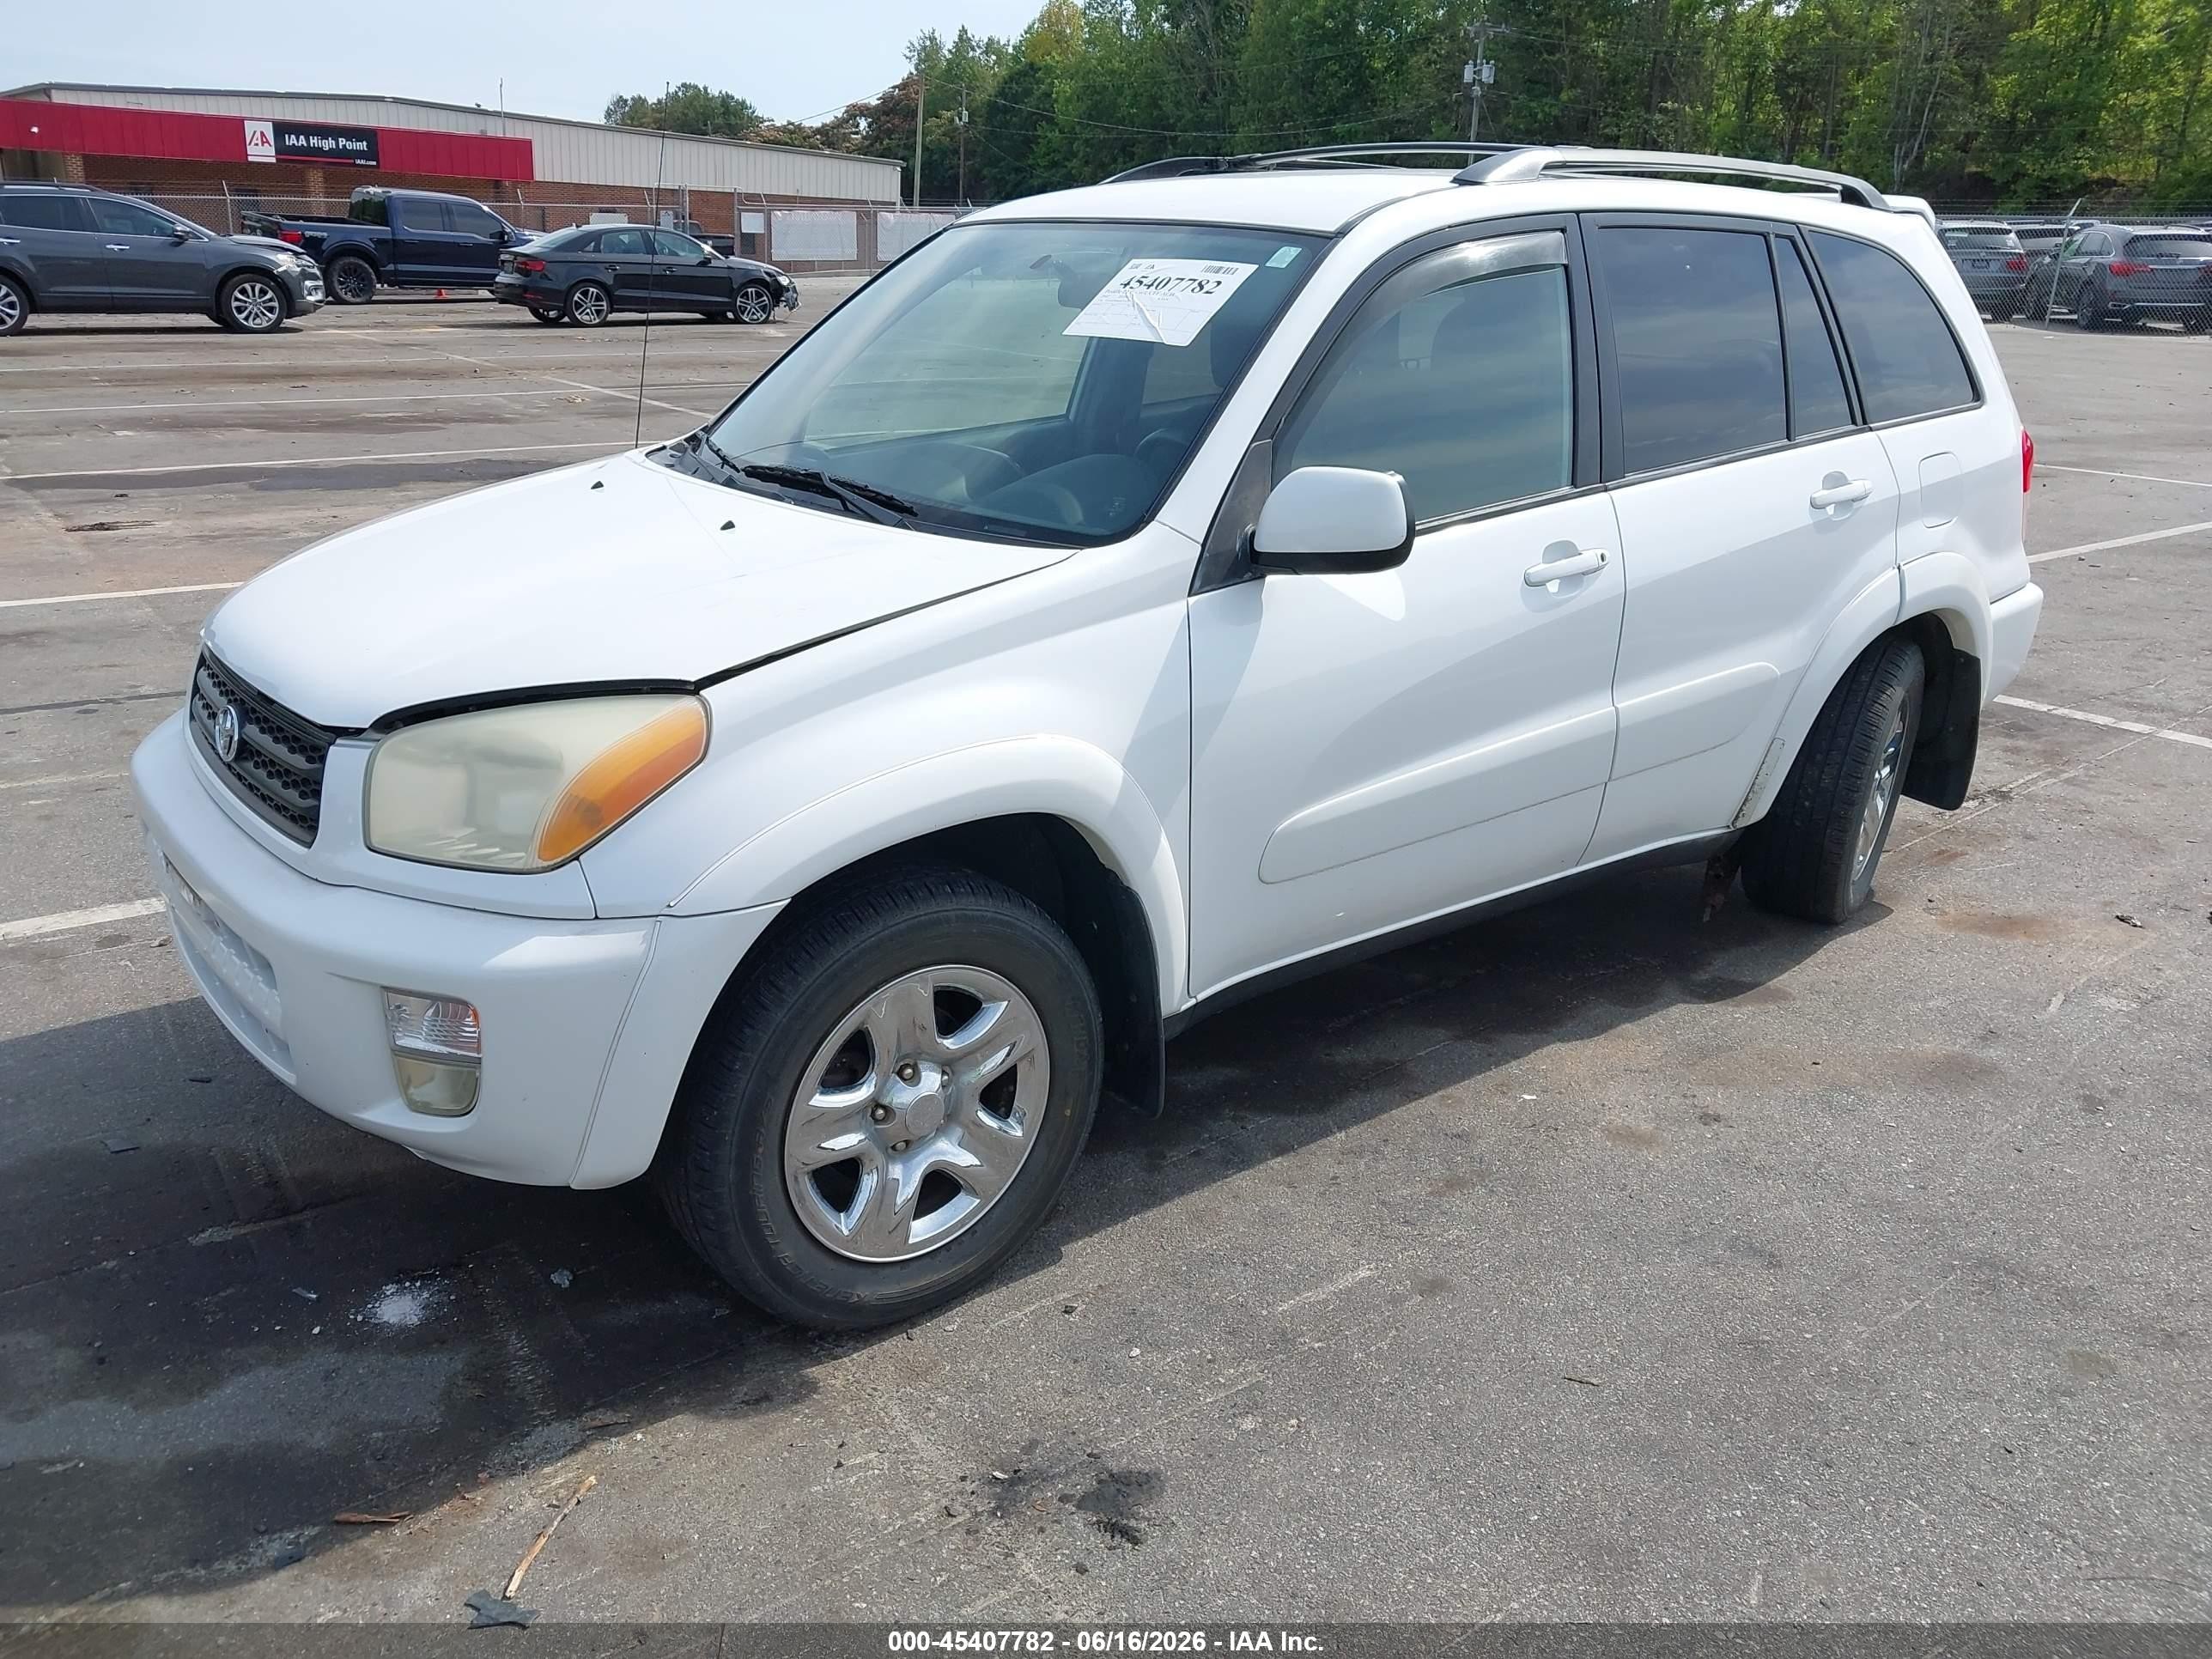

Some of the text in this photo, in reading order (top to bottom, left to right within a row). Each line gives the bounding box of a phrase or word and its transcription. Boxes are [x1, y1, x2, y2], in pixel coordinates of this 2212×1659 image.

[285, 134, 368, 151] IAA High Point
[1120, 275, 1223, 295] 45407782
